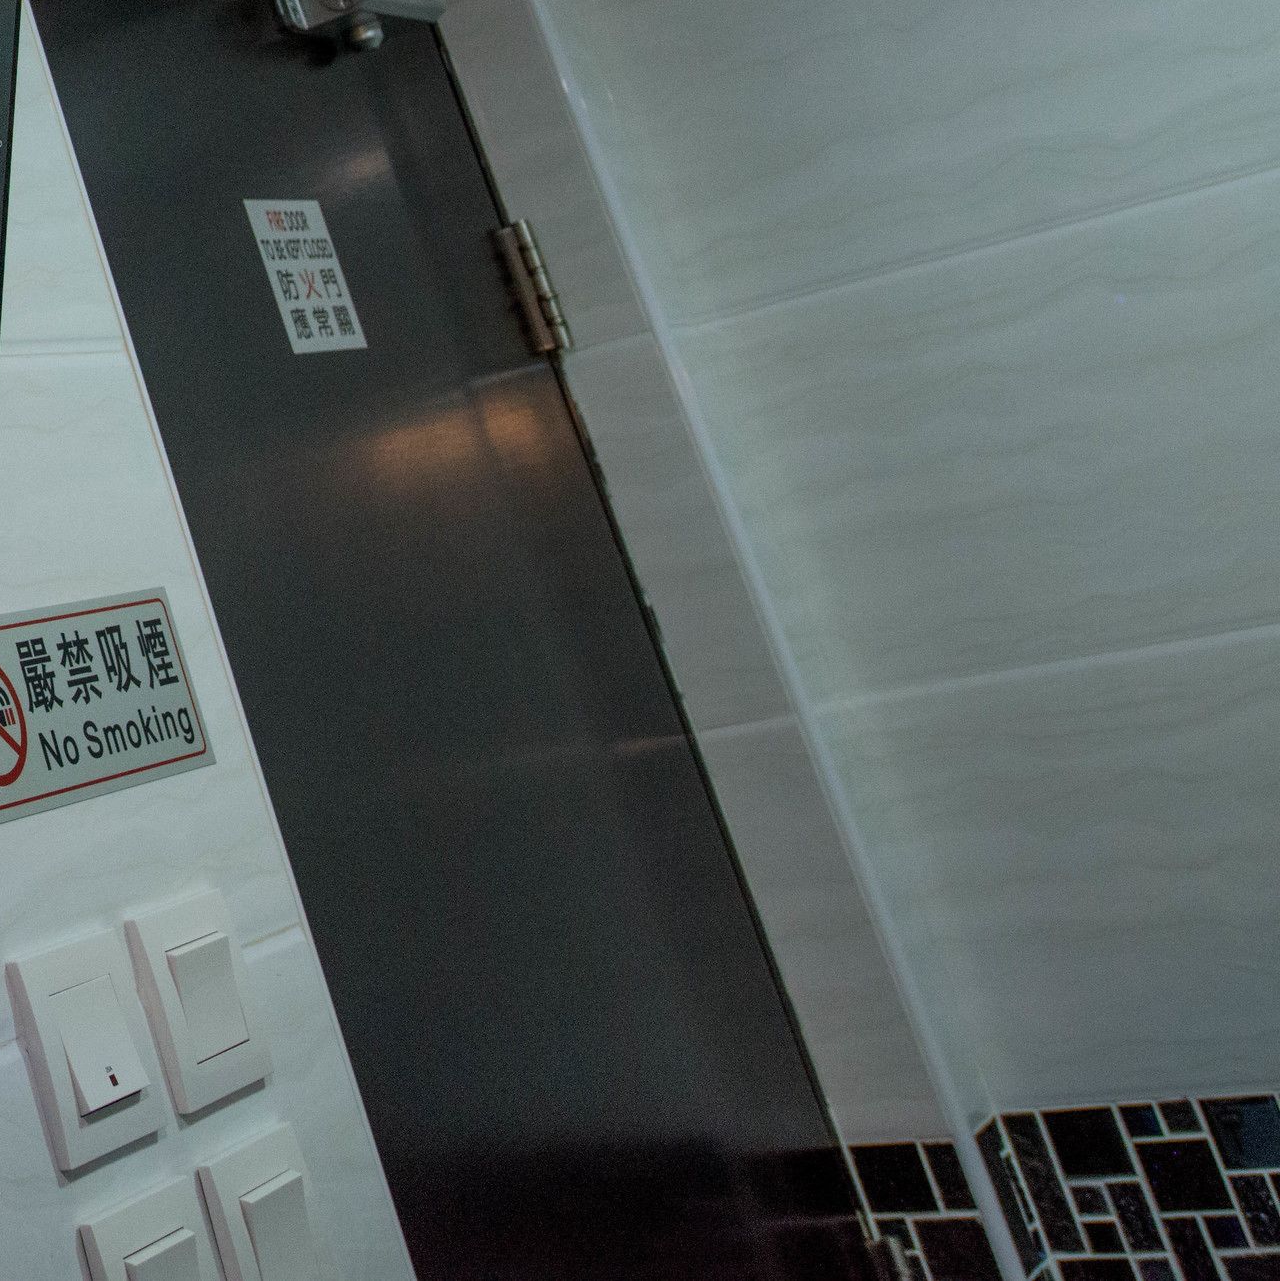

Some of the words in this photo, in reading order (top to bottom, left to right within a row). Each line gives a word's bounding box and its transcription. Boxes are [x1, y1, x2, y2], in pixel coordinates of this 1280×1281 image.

[277, 269, 342, 300] 防火門
[15, 617, 179, 714] 嚴禁吸煙
[38, 729, 80, 771] No
[83, 706, 195, 760] Smoking
